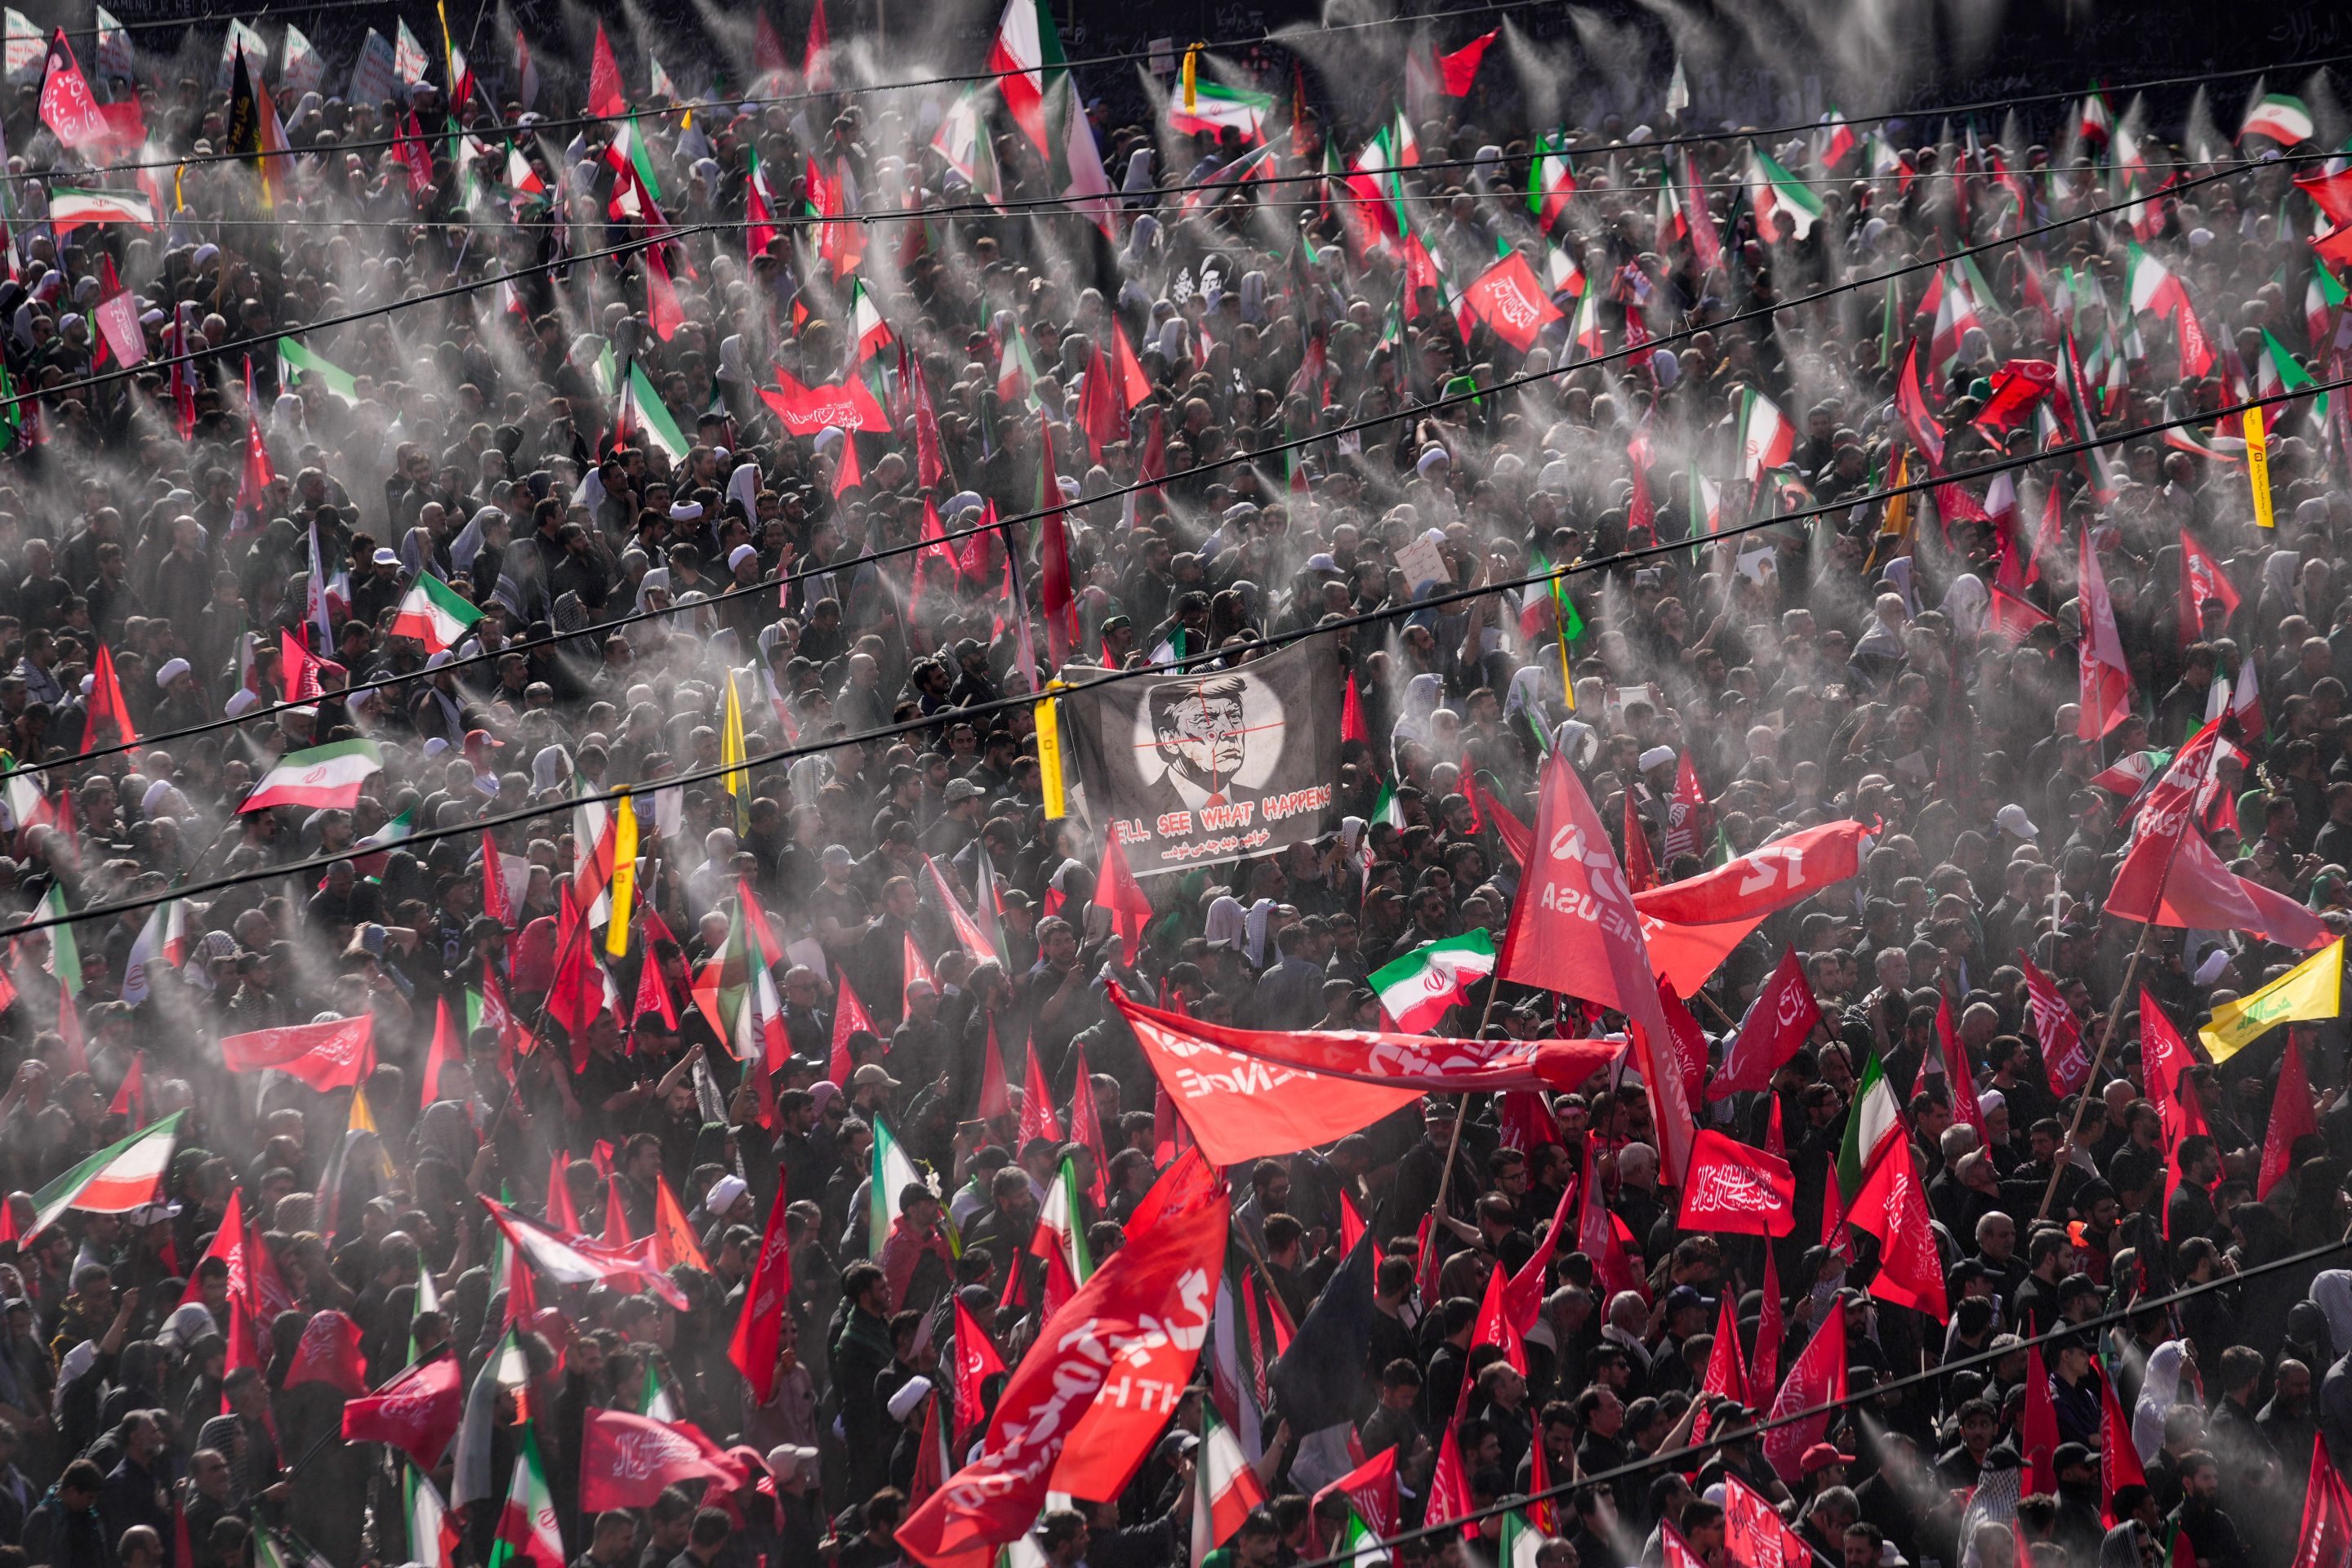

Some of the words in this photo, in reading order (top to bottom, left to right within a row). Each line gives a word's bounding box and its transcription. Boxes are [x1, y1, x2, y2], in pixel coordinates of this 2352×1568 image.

[1105, 818, 1151, 844] E'LL
[1157, 812, 1192, 838] SEE
[1200, 801, 1254, 831] WHAT
[1263, 783, 1331, 821] HAPPENS
[1220, 835, 1238, 851] دید
[1238, 828, 1270, 849] خواهیم
[1192, 842, 1205, 858] می
[1206, 840, 1219, 854] چه
